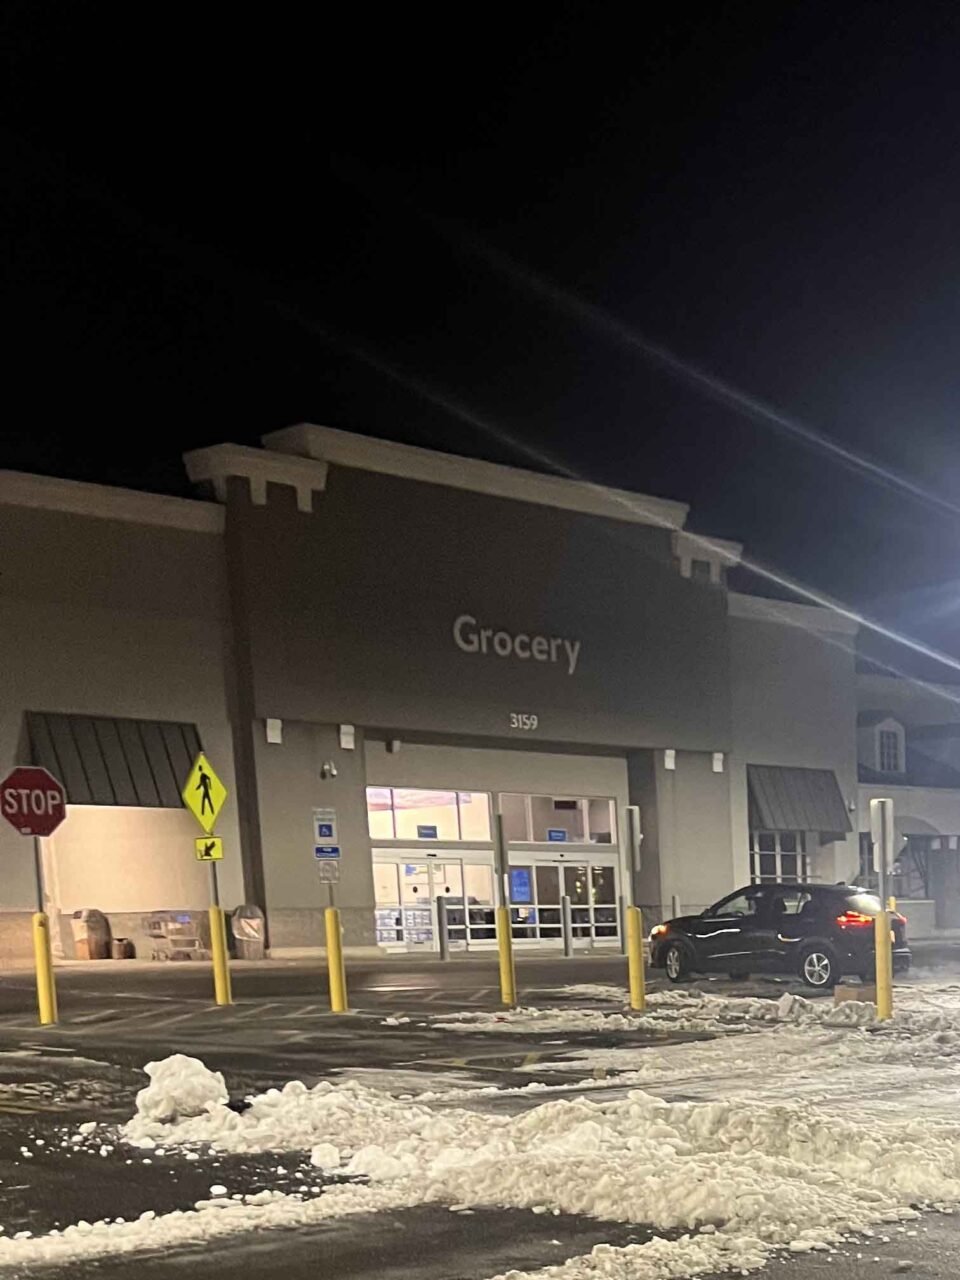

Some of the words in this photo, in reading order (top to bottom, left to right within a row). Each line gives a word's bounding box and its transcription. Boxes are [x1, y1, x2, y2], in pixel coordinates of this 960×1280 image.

[453, 614, 581, 675] Grocery
[509, 713, 538, 730] 3159
[4, 788, 61, 816] STOP
